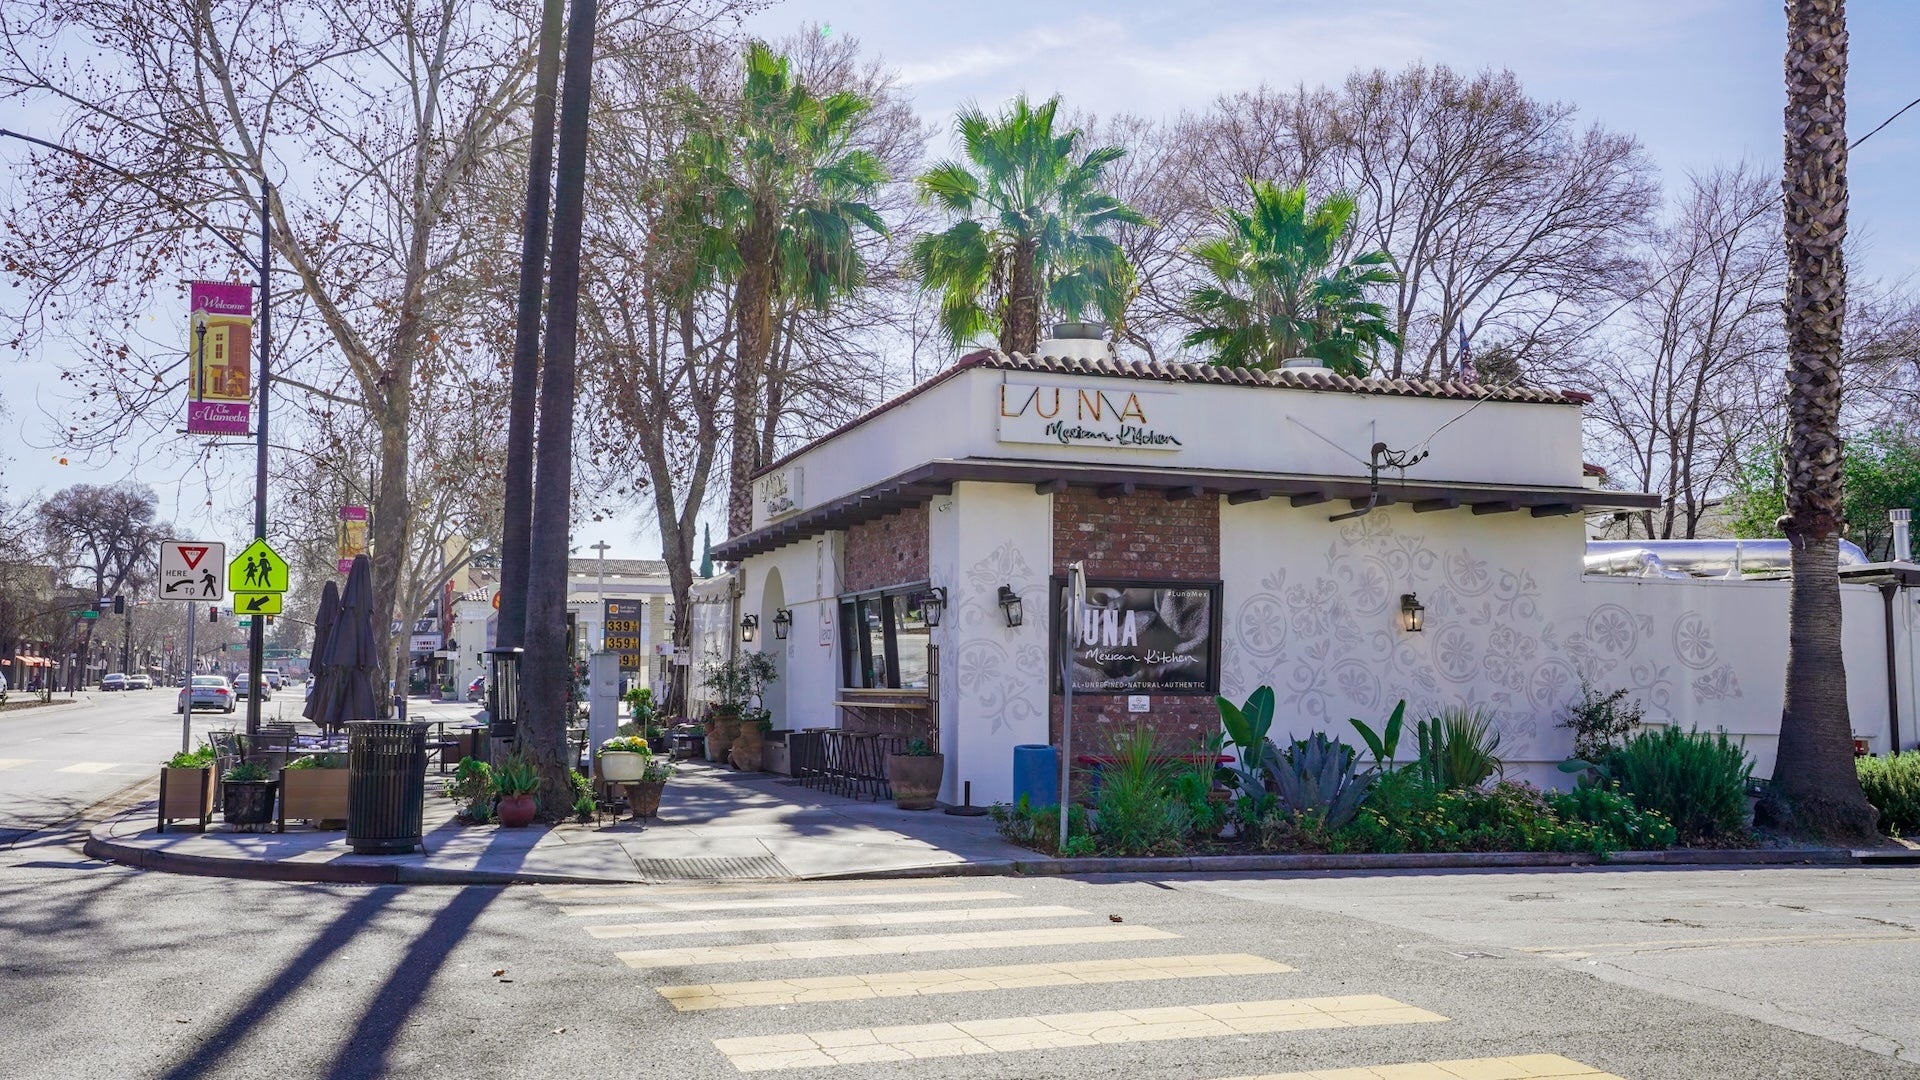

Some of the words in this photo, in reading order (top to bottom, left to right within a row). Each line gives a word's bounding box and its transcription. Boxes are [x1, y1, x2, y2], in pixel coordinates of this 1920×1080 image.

[198, 295, 245, 310] Welcome
[215, 403, 229, 414] The
[1001, 384, 1147, 423] LUNA
[1045, 420, 1114, 444] Mexican
[1116, 424, 1182, 446] Kitchen
[608, 620, 630, 632] 339
[1083, 609, 1138, 647] UNA
[608, 637, 630, 649] 359
[1085, 648, 1140, 665] Mexican
[1144, 649, 1199, 664] Kitchen
